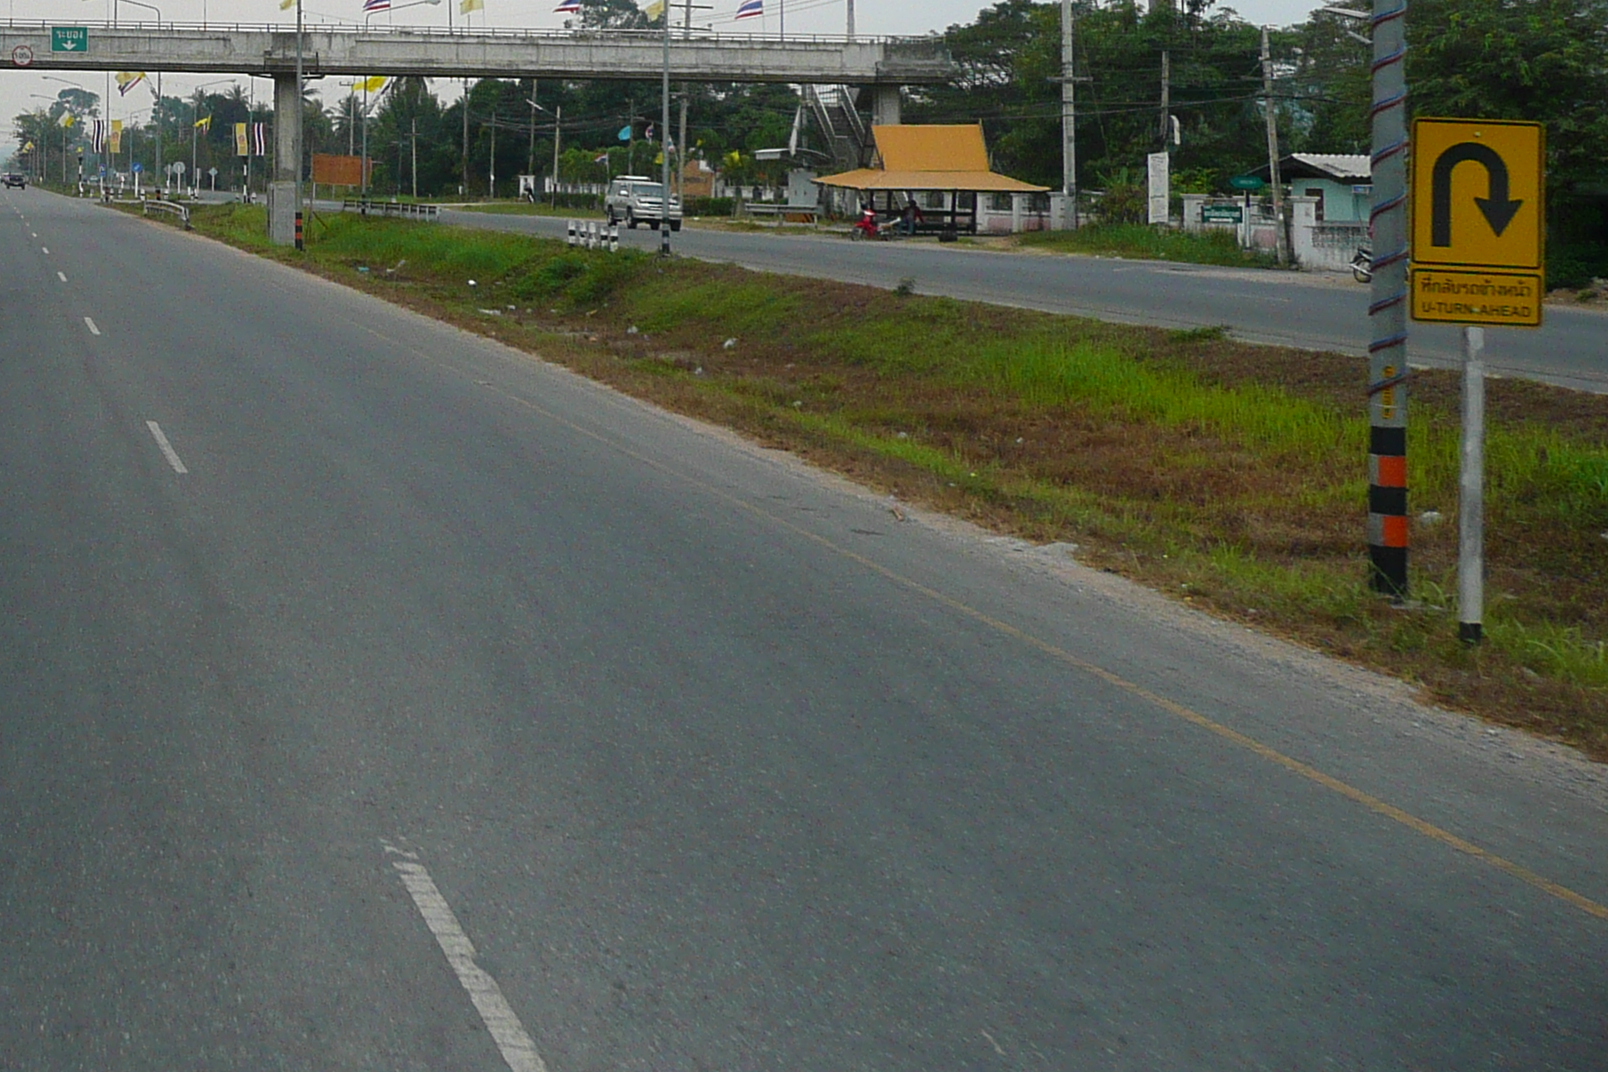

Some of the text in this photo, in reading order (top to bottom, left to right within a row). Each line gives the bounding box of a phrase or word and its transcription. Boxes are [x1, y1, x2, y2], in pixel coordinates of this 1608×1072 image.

[55, 30, 84, 39] ระยอง
[1420, 274, 1531, 297] ที่กลับรถข้างหน้า
[1421, 301, 1532, 318] U-TURN AHEAD
